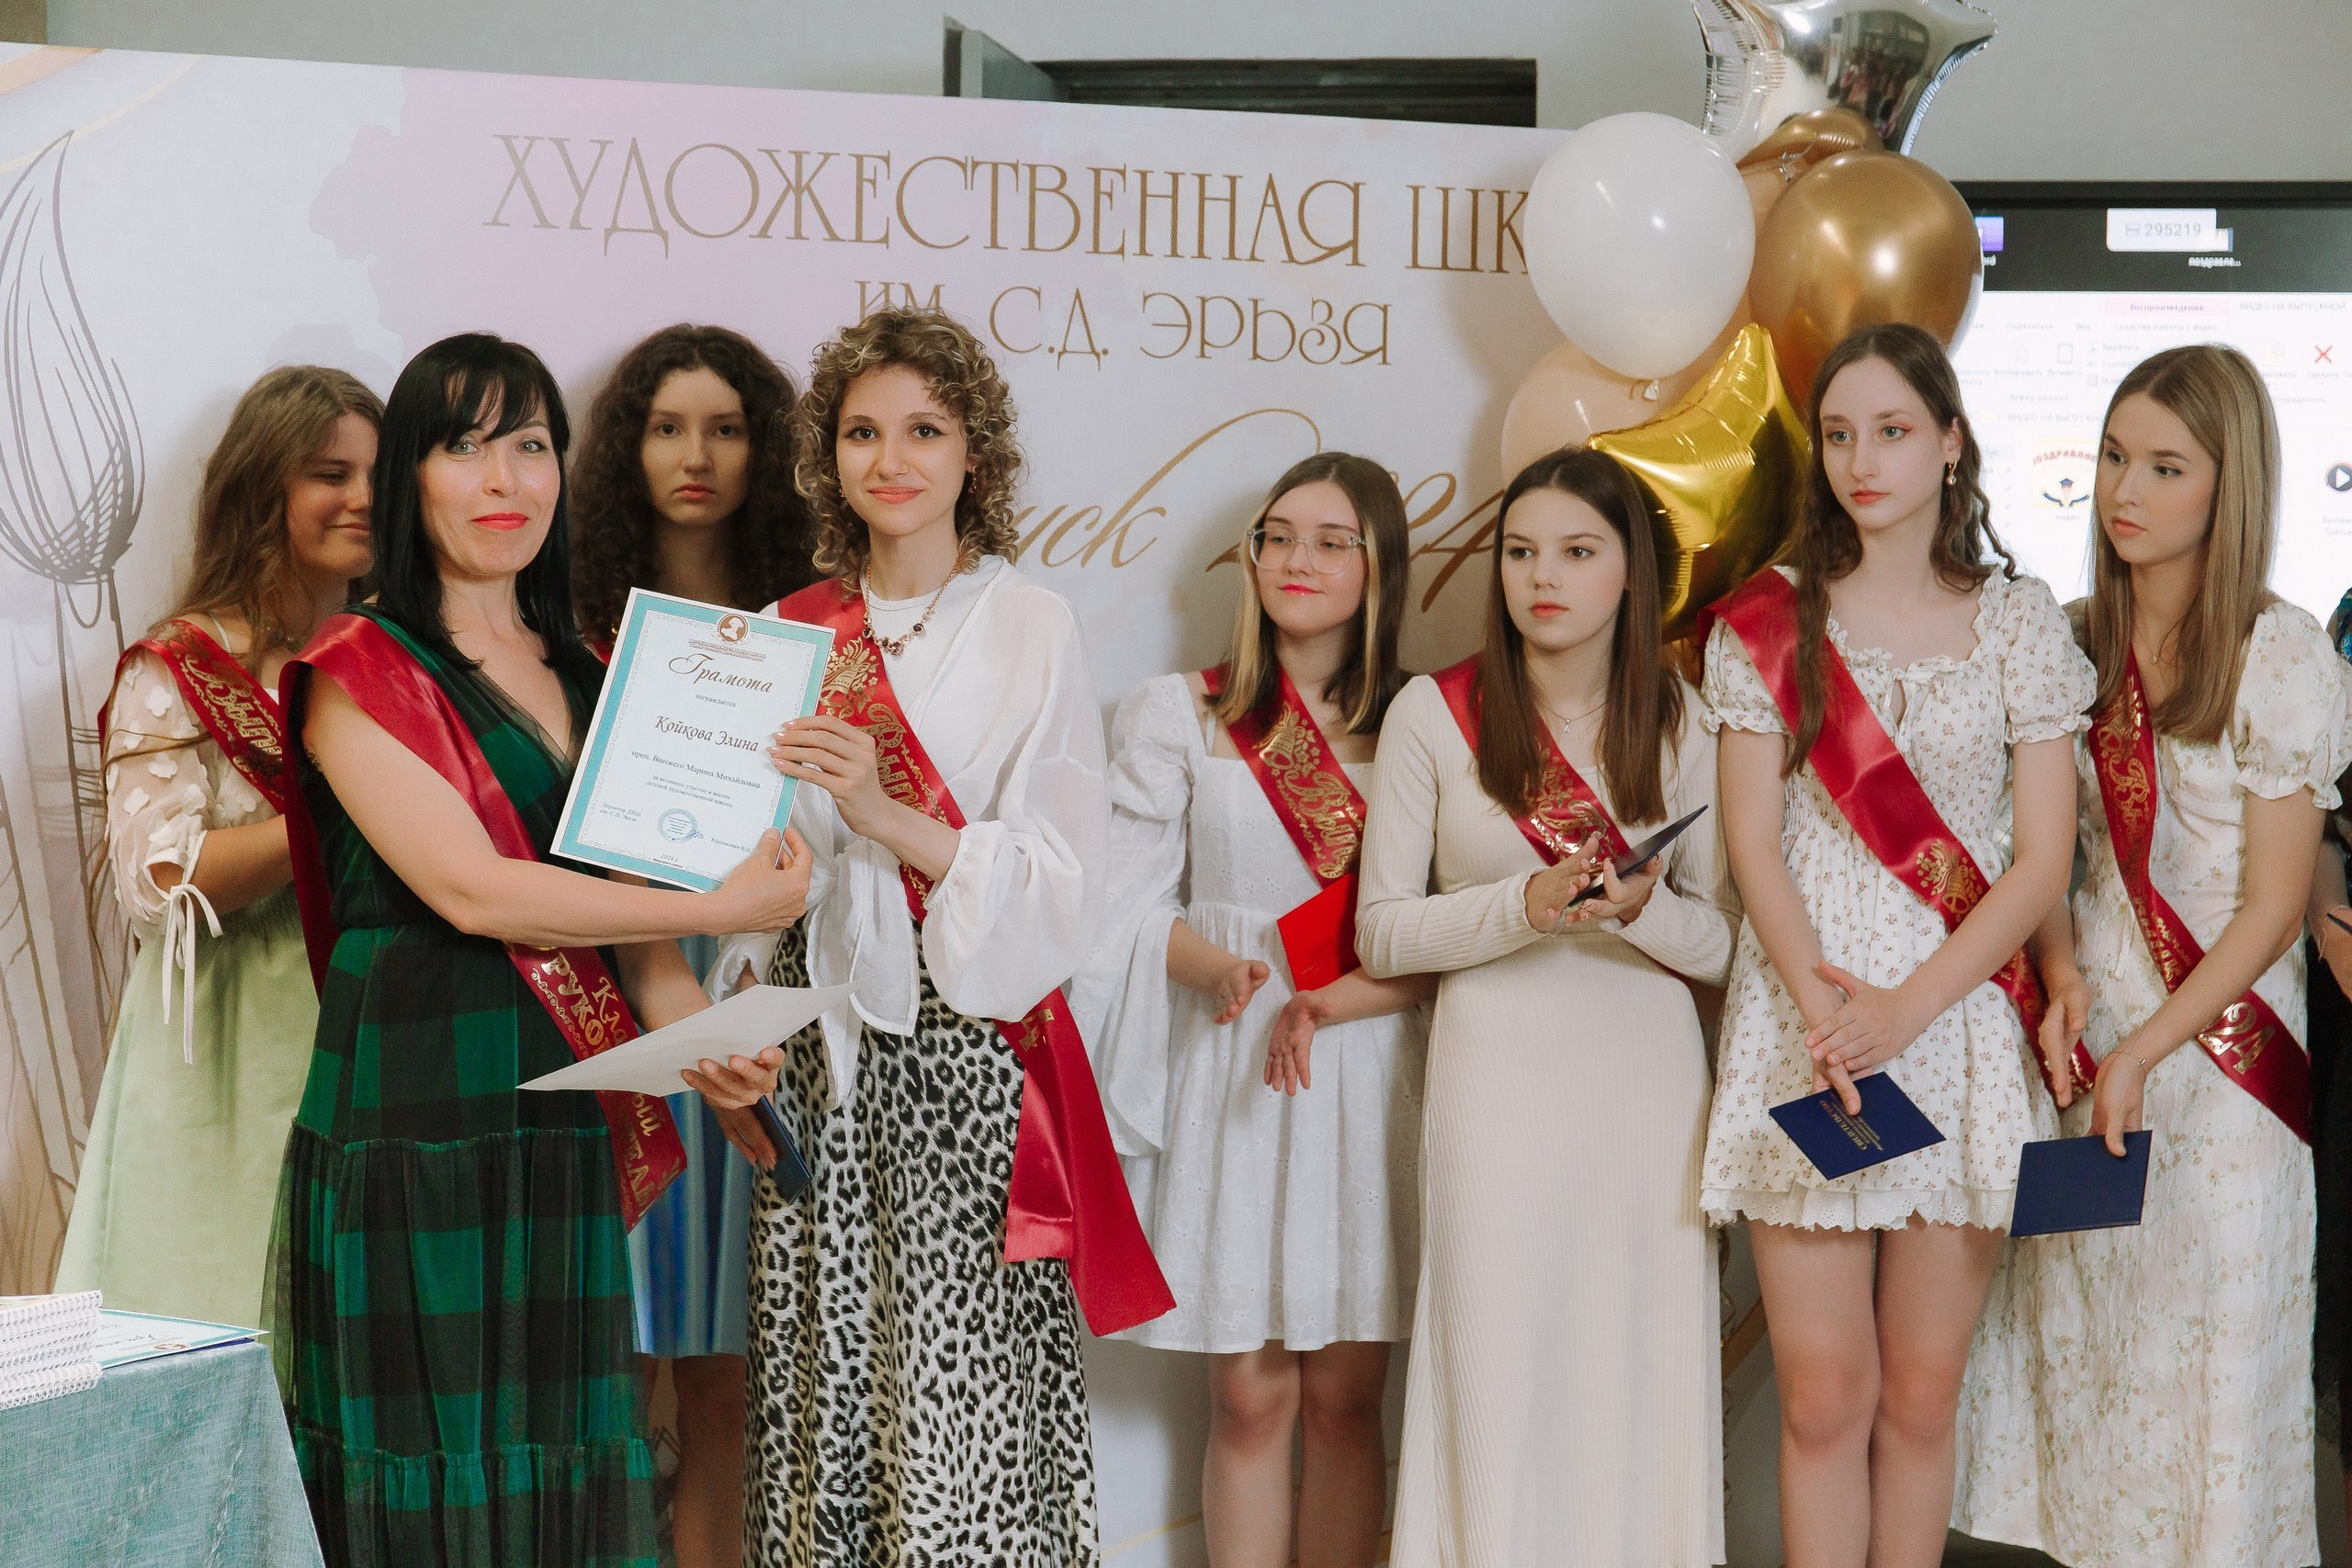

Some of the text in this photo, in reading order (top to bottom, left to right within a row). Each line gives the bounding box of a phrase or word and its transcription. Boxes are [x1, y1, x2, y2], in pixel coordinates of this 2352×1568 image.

[481, 133, 1367, 267] ХУДОЖЕСТВЕННАЯ
[2144, 222, 2201, 237] 295219
[989, 285, 1110, 371] С.Д.
[1139, 289, 1394, 367] ЭРЬЗЯ
[668, 653, 774, 694] Грамота
[654, 715, 760, 752] Койкова Элина
[685, 763, 715, 778] Марина
[715, 771, 762, 790] Михайловна
